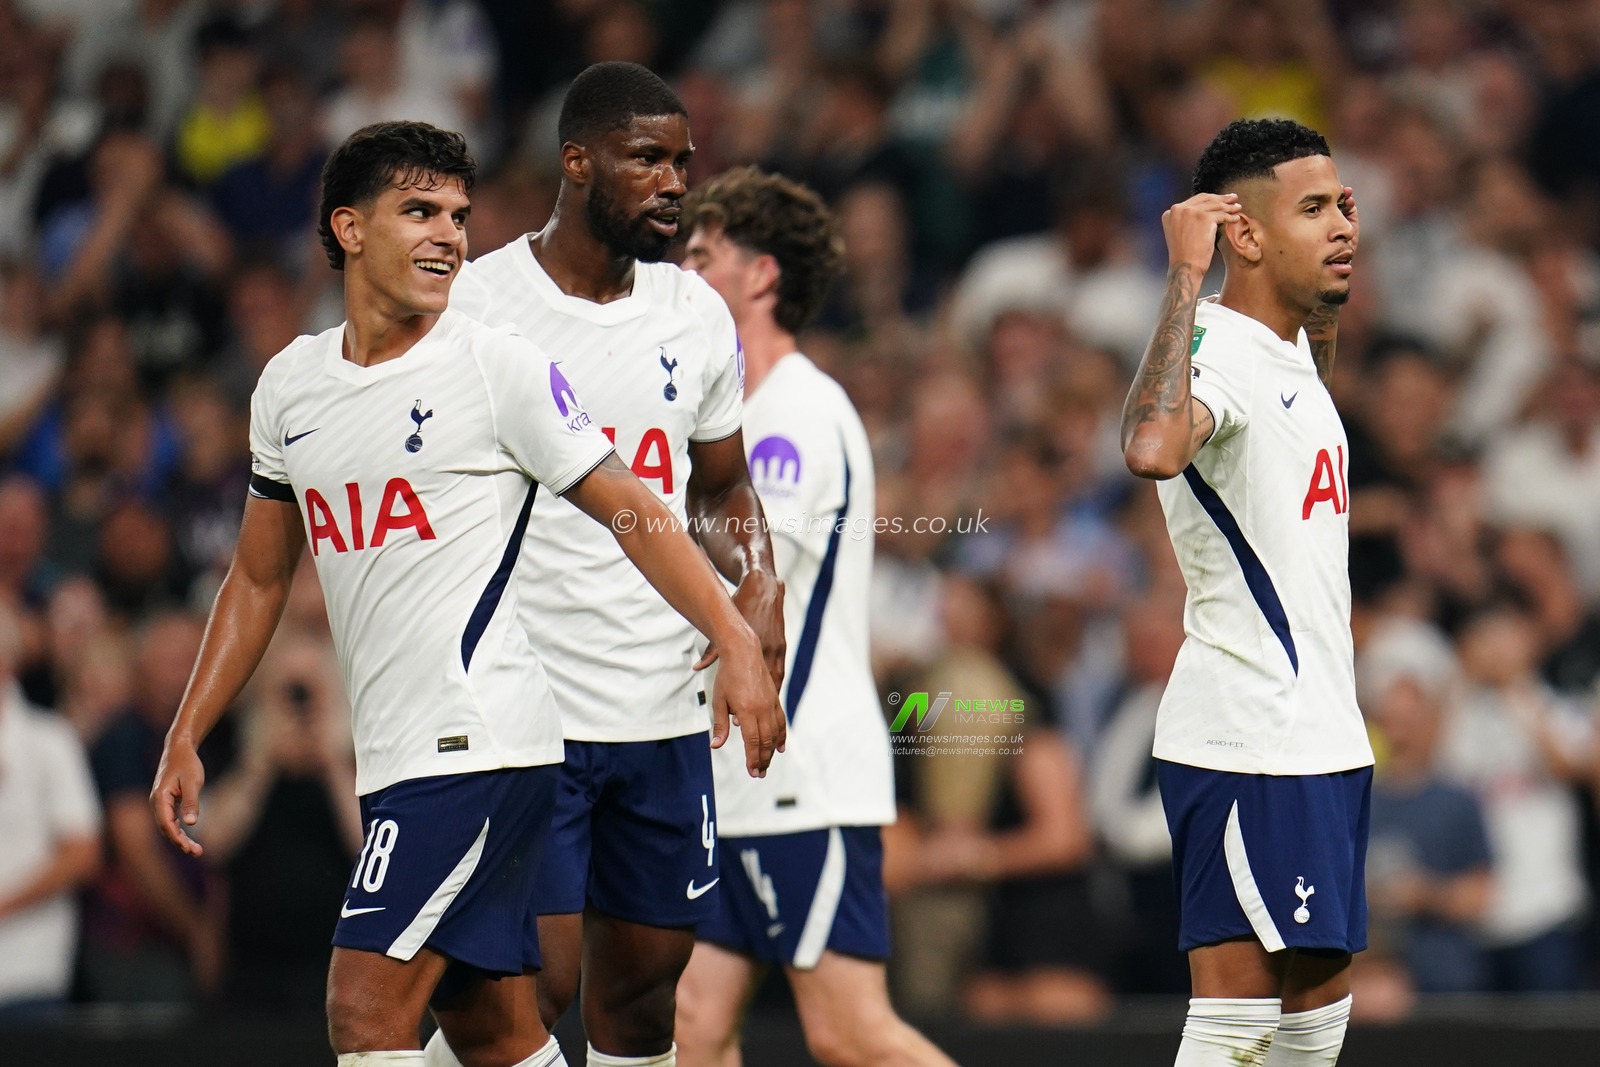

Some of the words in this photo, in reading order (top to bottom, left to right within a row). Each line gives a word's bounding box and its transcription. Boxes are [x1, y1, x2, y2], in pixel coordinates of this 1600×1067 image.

[305, 477, 437, 556] AIA
[1205, 739, 1244, 748] AERO-FIT
[352, 818, 400, 894] 18
[701, 794, 716, 867] 4
